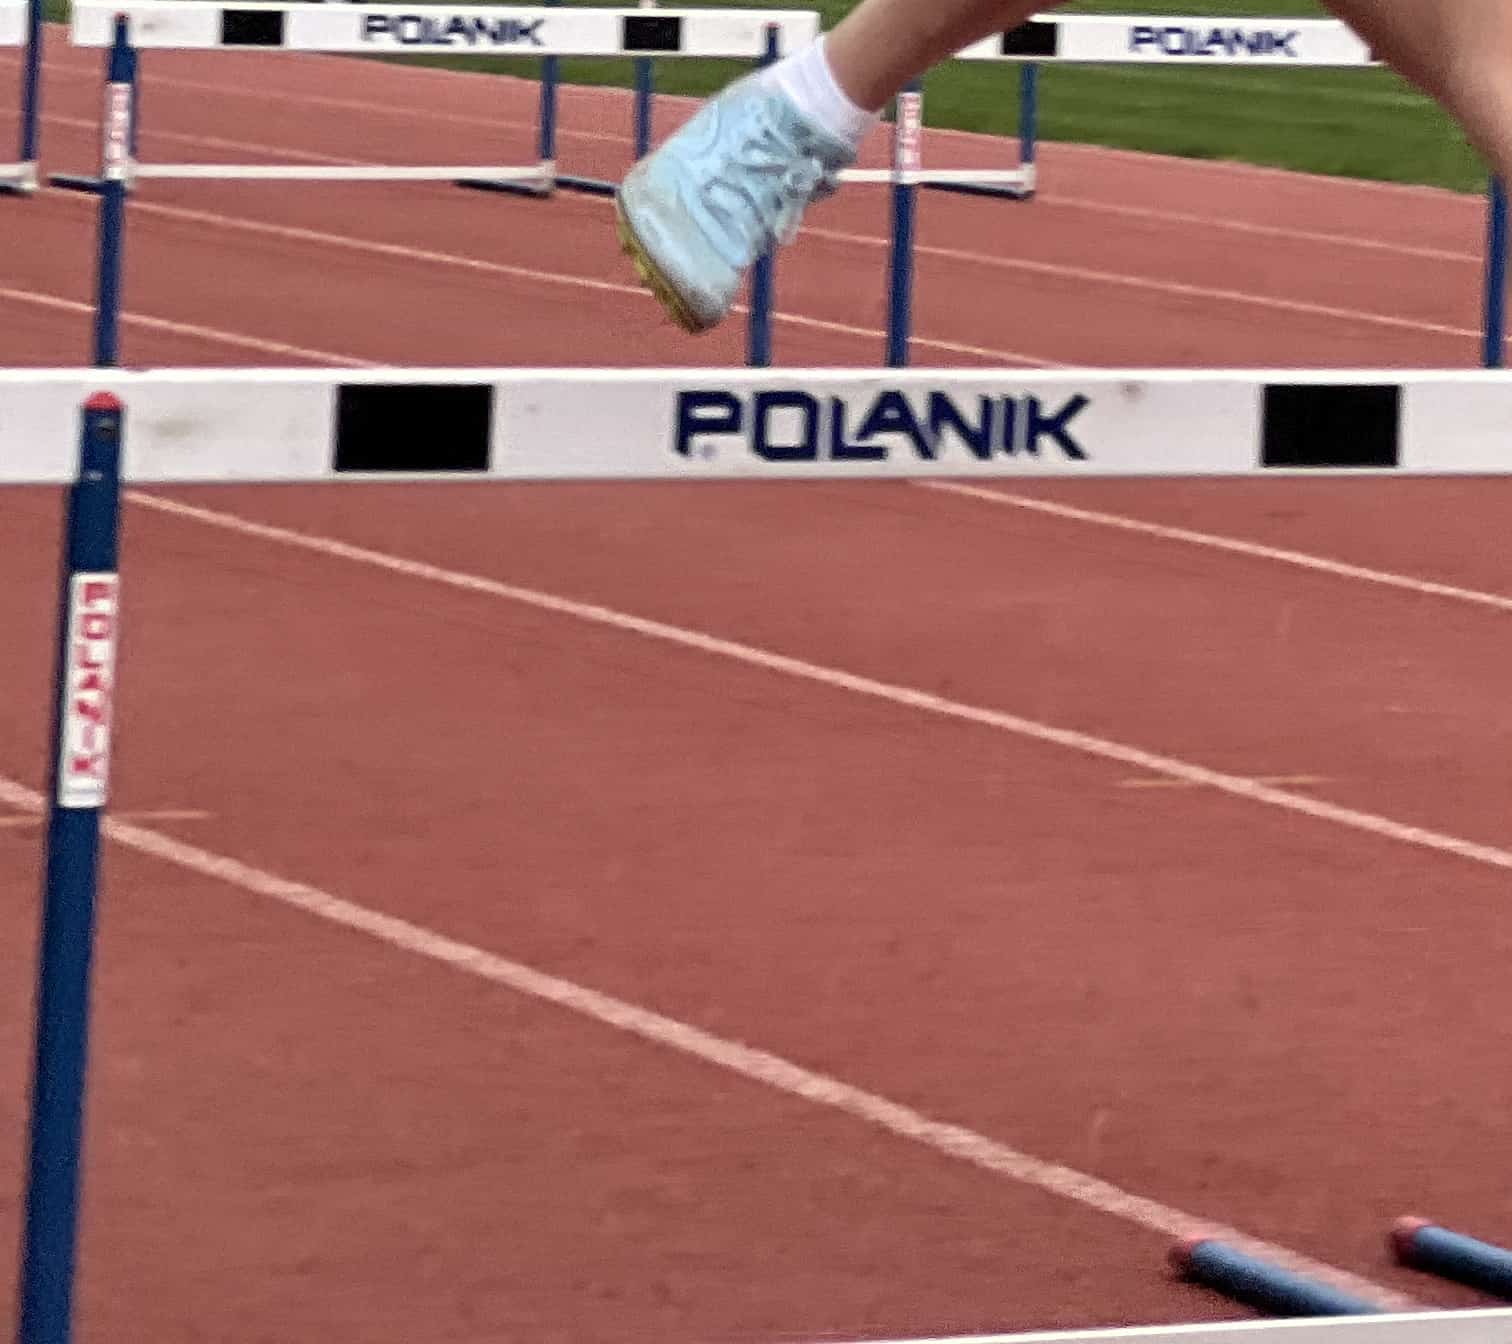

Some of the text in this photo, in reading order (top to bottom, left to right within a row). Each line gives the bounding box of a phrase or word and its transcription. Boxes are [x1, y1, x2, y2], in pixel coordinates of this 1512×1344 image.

[362, 14, 546, 47] POLANIK
[1131, 25, 1299, 58] POLANIK
[674, 389, 1091, 462] POLANIK
